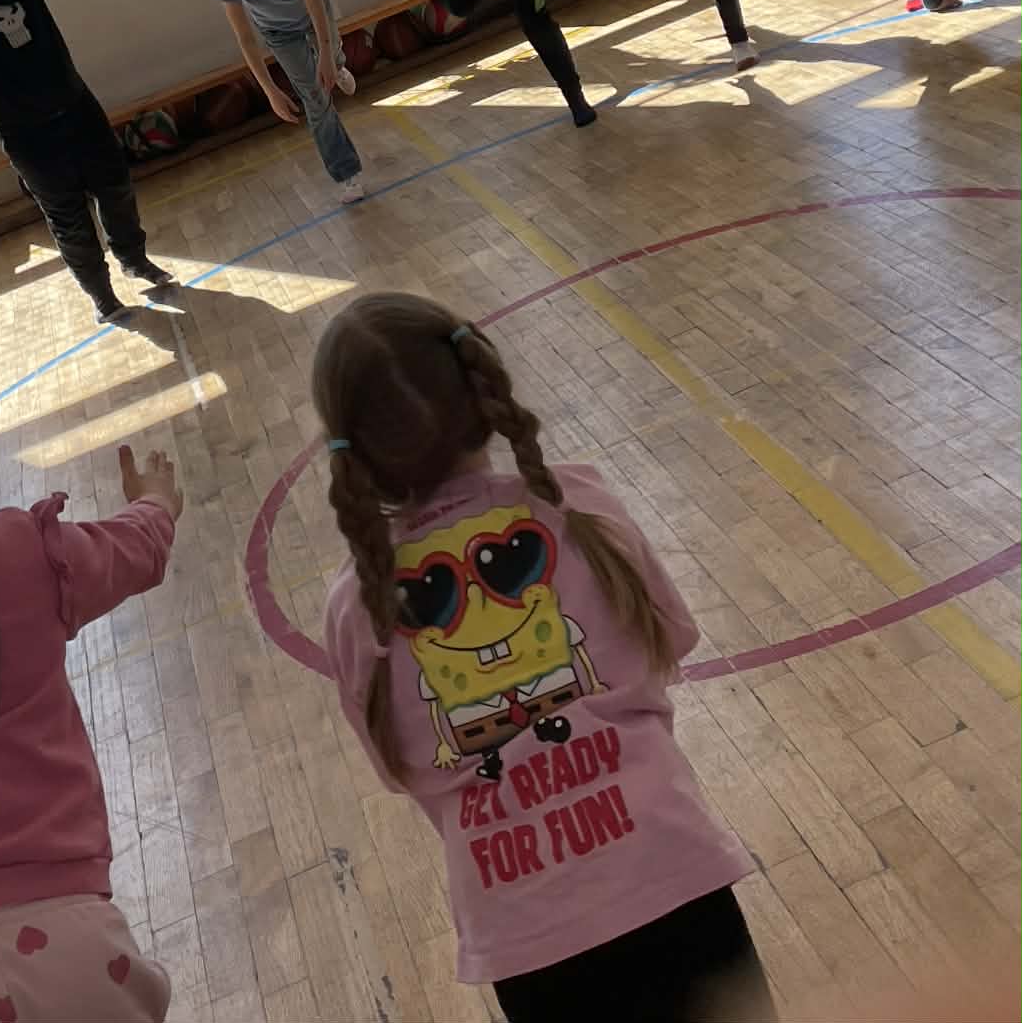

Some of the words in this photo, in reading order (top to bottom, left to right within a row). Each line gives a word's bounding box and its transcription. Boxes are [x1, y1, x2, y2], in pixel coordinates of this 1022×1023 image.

[459, 783, 509, 830] GET
[507, 726, 622, 811] READY
[469, 824, 545, 890] FOR
[543, 784, 635, 864] FUN!
